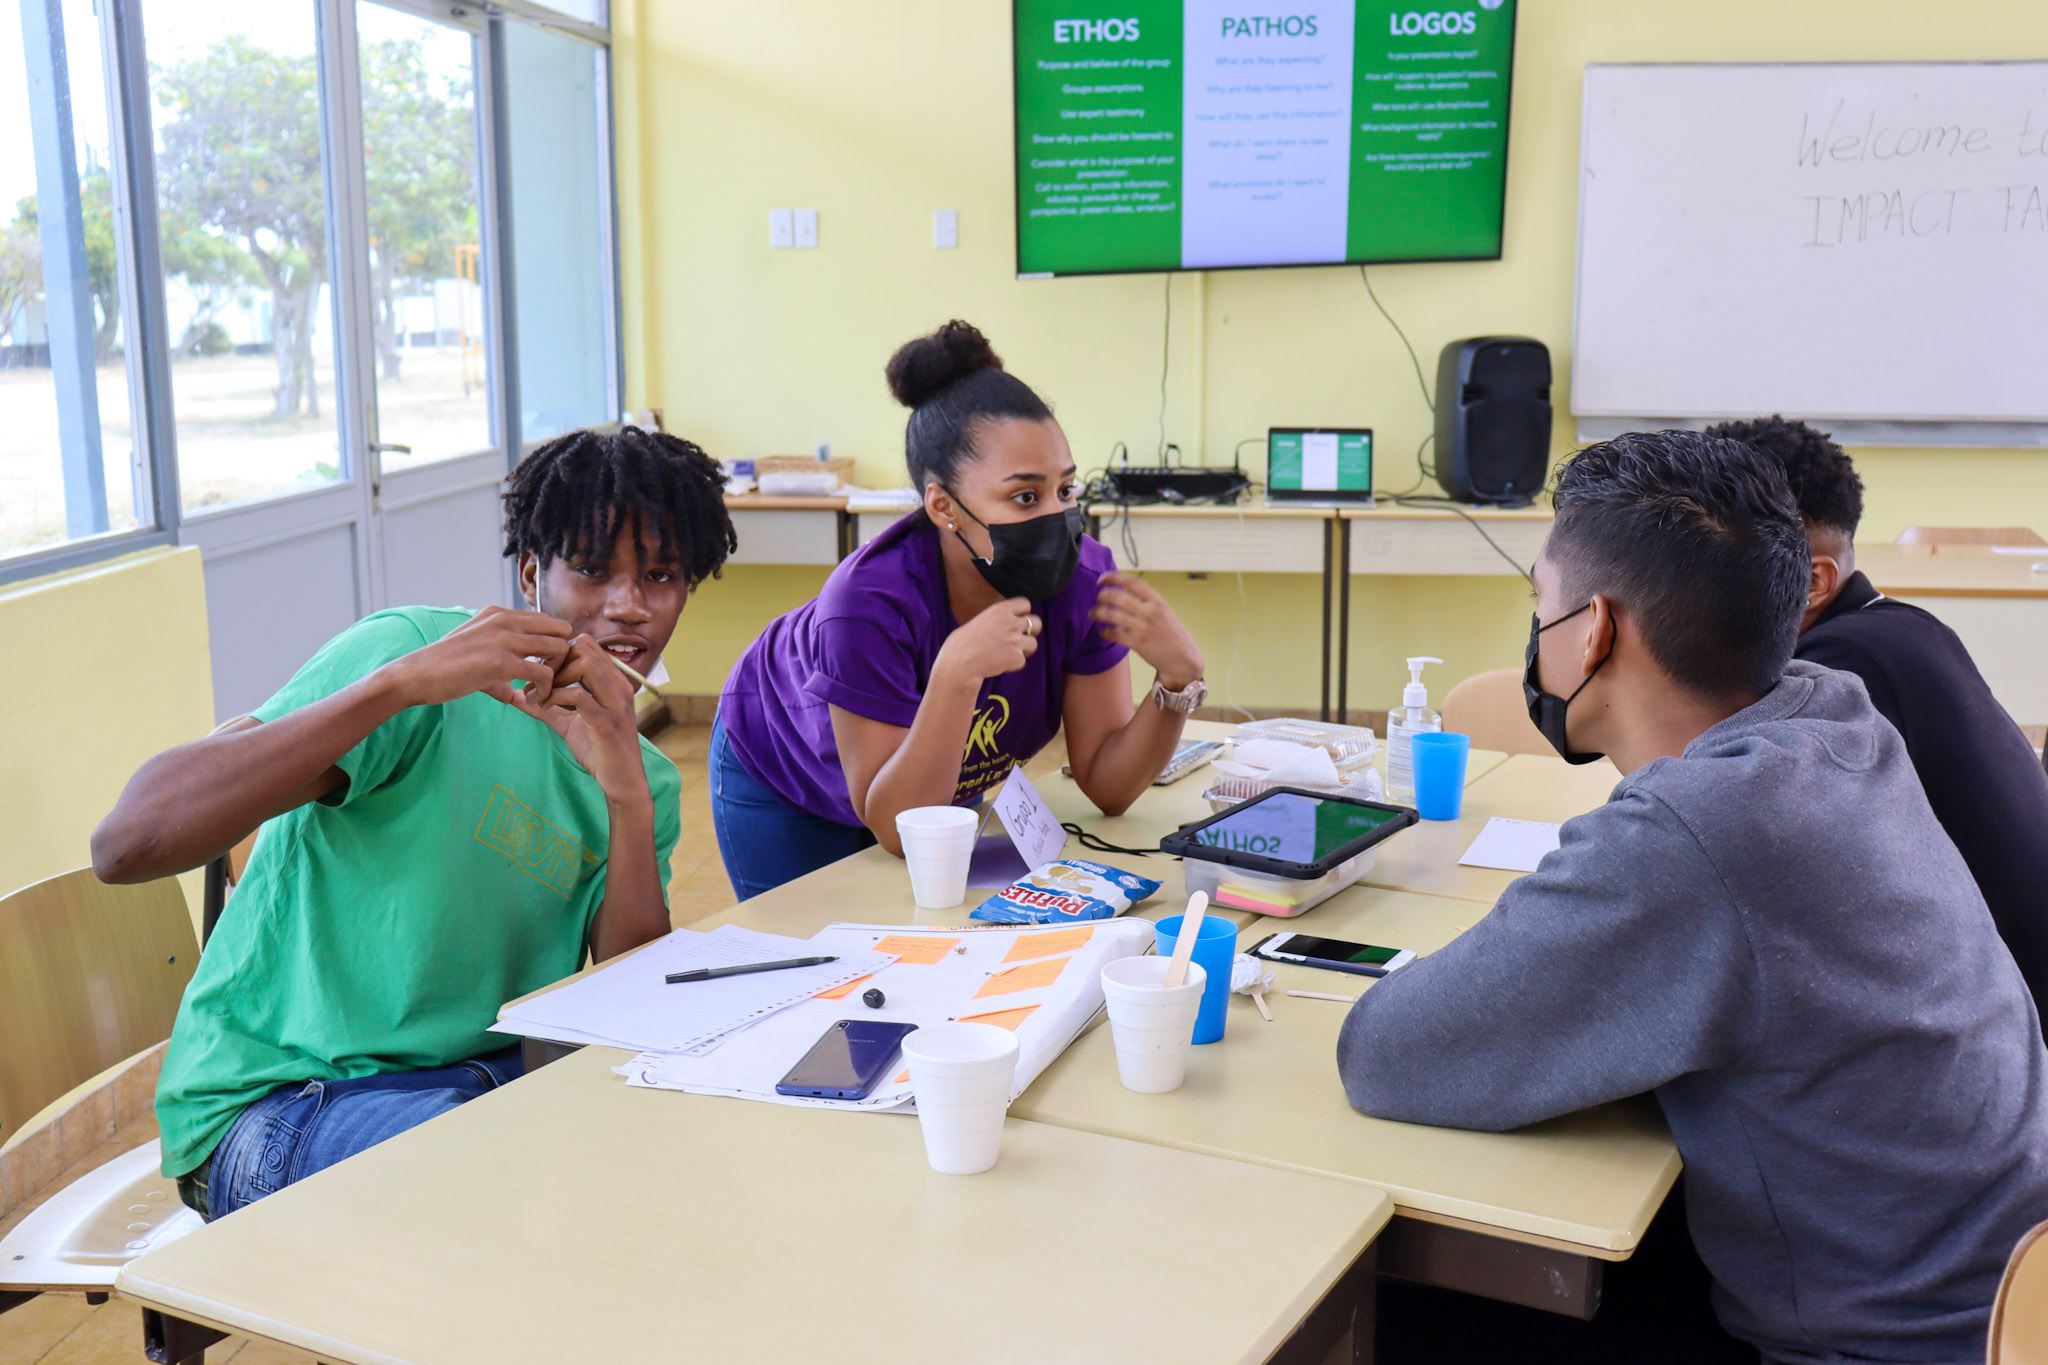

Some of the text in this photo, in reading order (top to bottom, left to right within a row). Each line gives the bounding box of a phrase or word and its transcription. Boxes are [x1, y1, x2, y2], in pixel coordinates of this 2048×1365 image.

[1053, 18, 1140, 43] ETHOS
[1221, 15, 1318, 38] PATHOS
[1390, 11, 1477, 36] LOGOS
[1797, 98, 1991, 168] Welcome
[1797, 184, 2048, 248] IMPACT FA
[1000, 886, 1092, 915] RUFFLES
